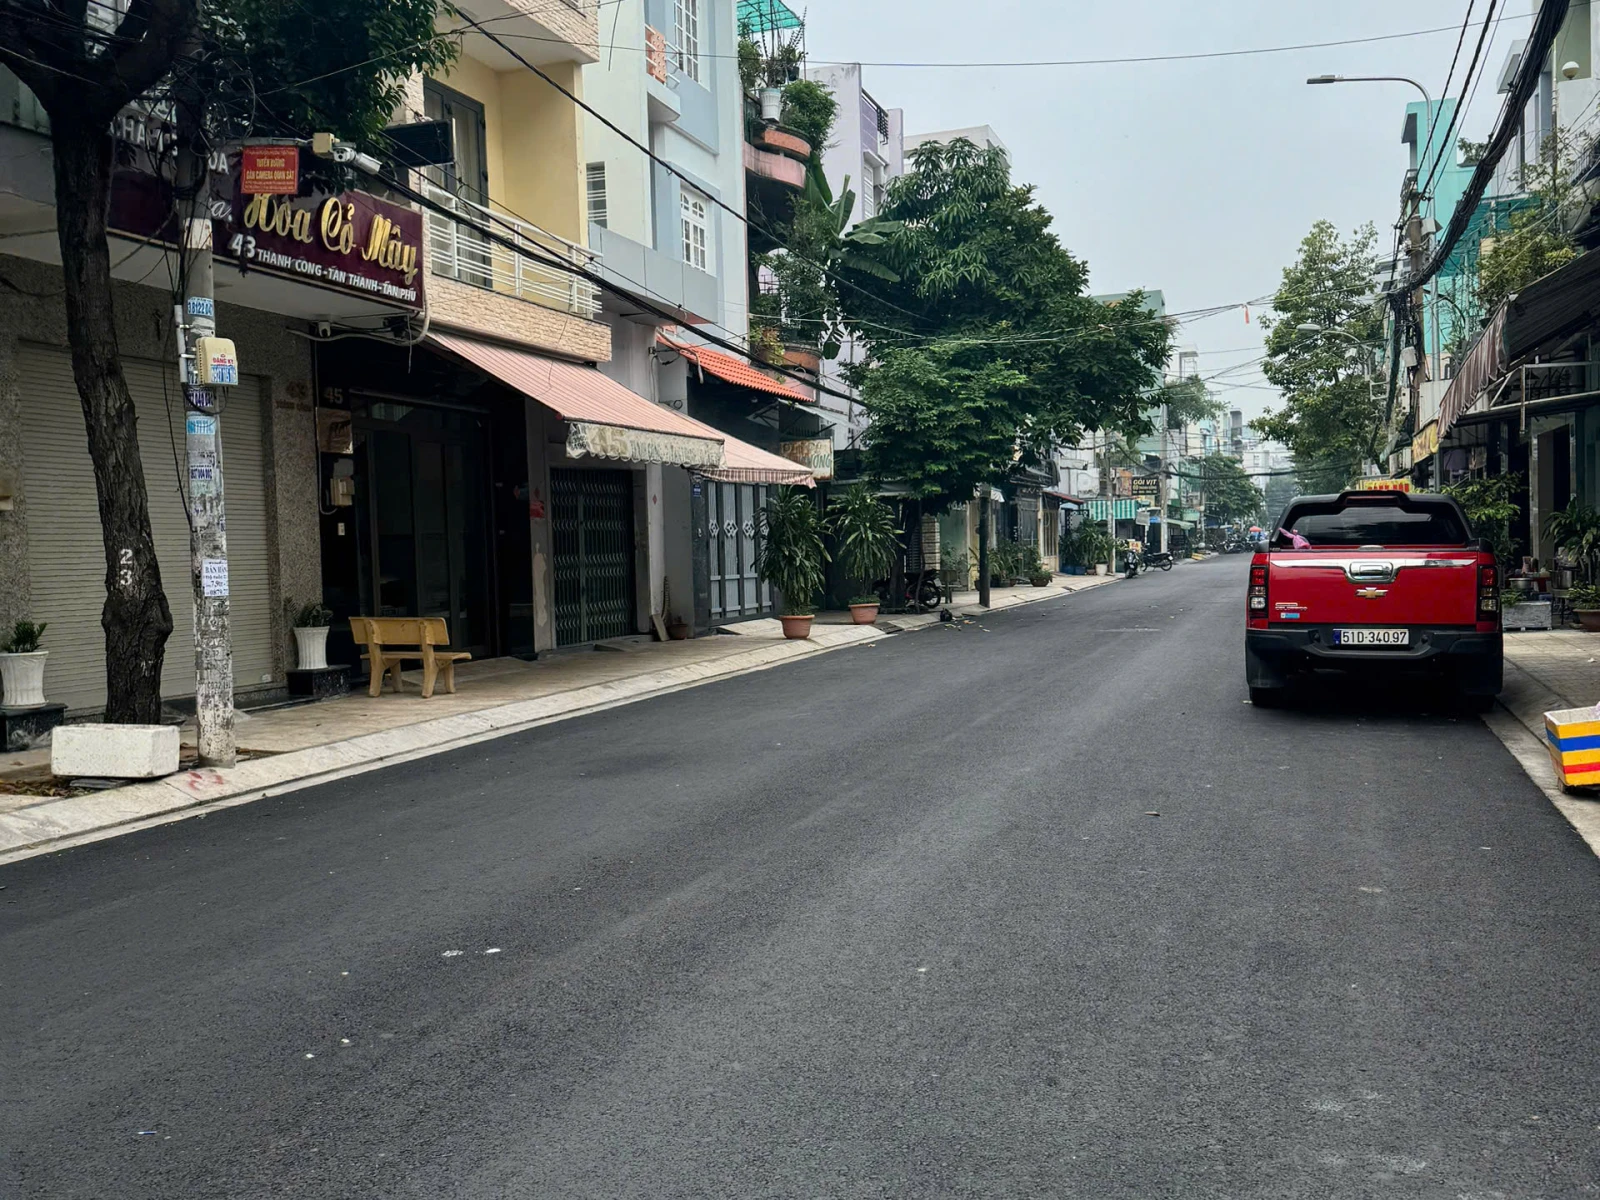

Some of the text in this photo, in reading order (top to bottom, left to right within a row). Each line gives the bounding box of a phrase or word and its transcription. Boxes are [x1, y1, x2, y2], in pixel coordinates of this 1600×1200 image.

[231, 233, 256, 258] 43
[244, 193, 418, 285] Hoa Cỏ Mây
[324, 386, 344, 404] 45
[1342, 631, 1407, 643] 51D-340.97
